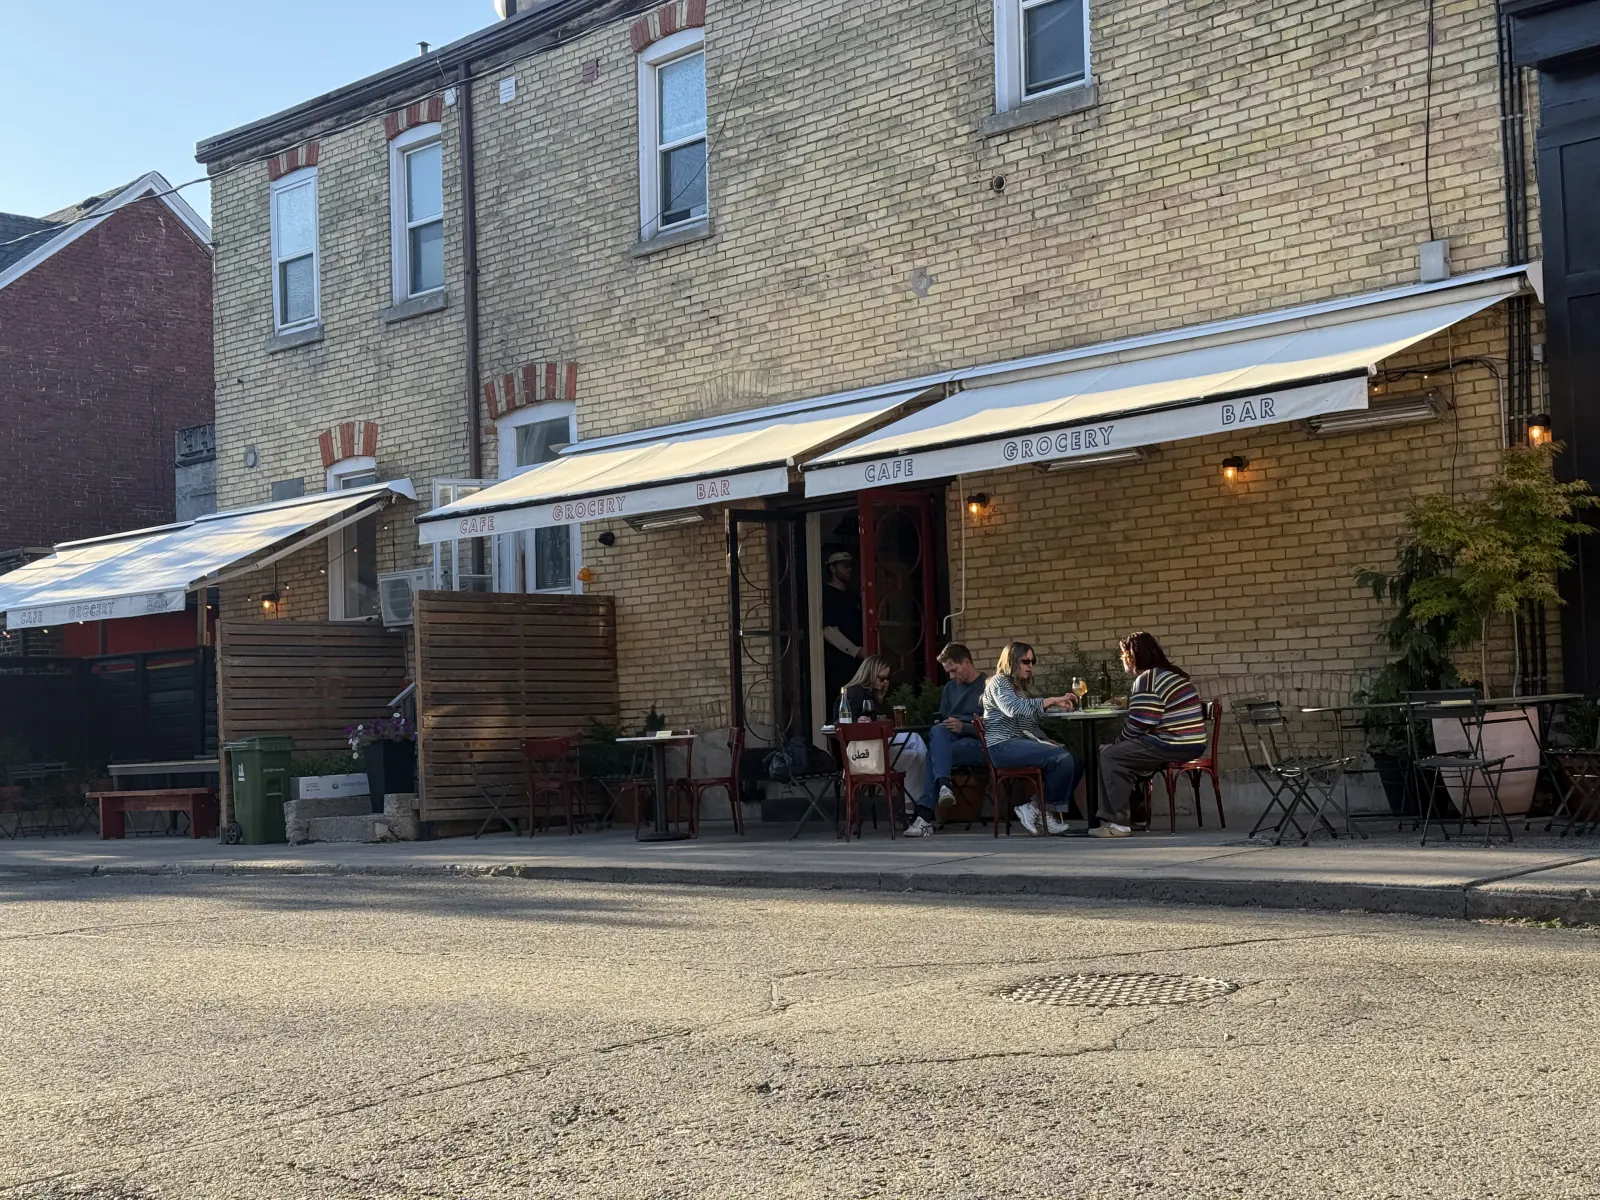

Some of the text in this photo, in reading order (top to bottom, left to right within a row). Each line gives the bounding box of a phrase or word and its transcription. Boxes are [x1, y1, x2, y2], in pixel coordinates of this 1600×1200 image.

[863, 397, 1276, 483] CAFE GROCERY BAR
[459, 479, 731, 535] CAFE GROCERY BAR
[19, 610, 43, 625] CAFE
